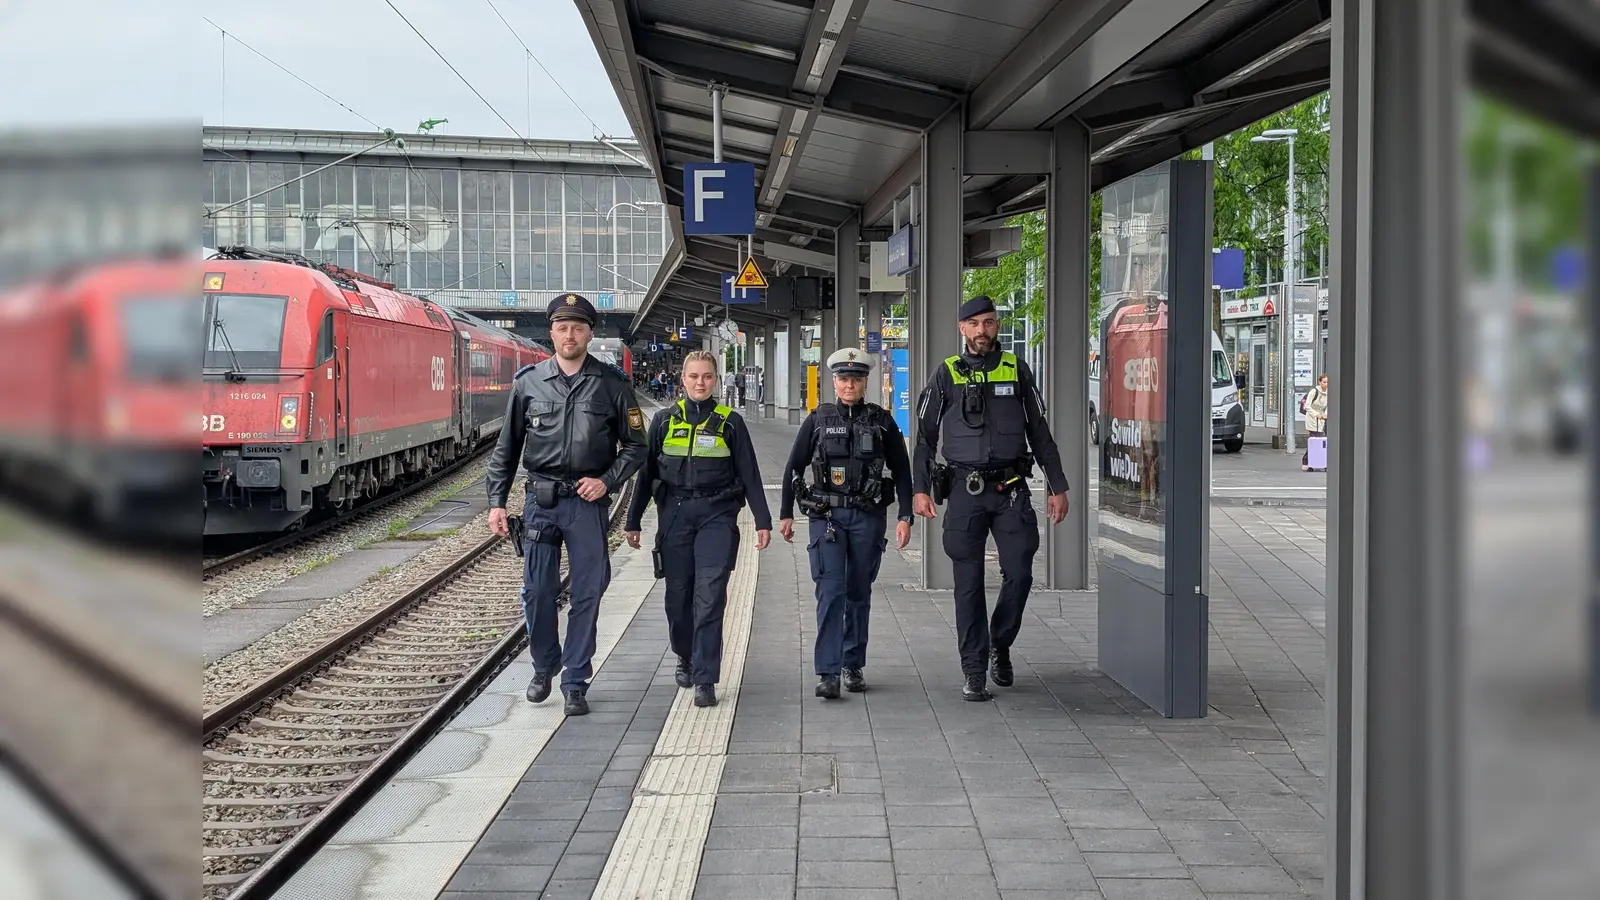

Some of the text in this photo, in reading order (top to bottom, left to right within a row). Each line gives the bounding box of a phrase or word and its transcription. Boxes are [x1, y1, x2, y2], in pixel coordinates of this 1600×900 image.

[694, 169, 726, 222] F
[679, 327, 688, 339] E
[651, 344, 658, 352] D
[431, 356, 445, 391] ÖBB
[246, 446, 282, 454] SIEMENS
